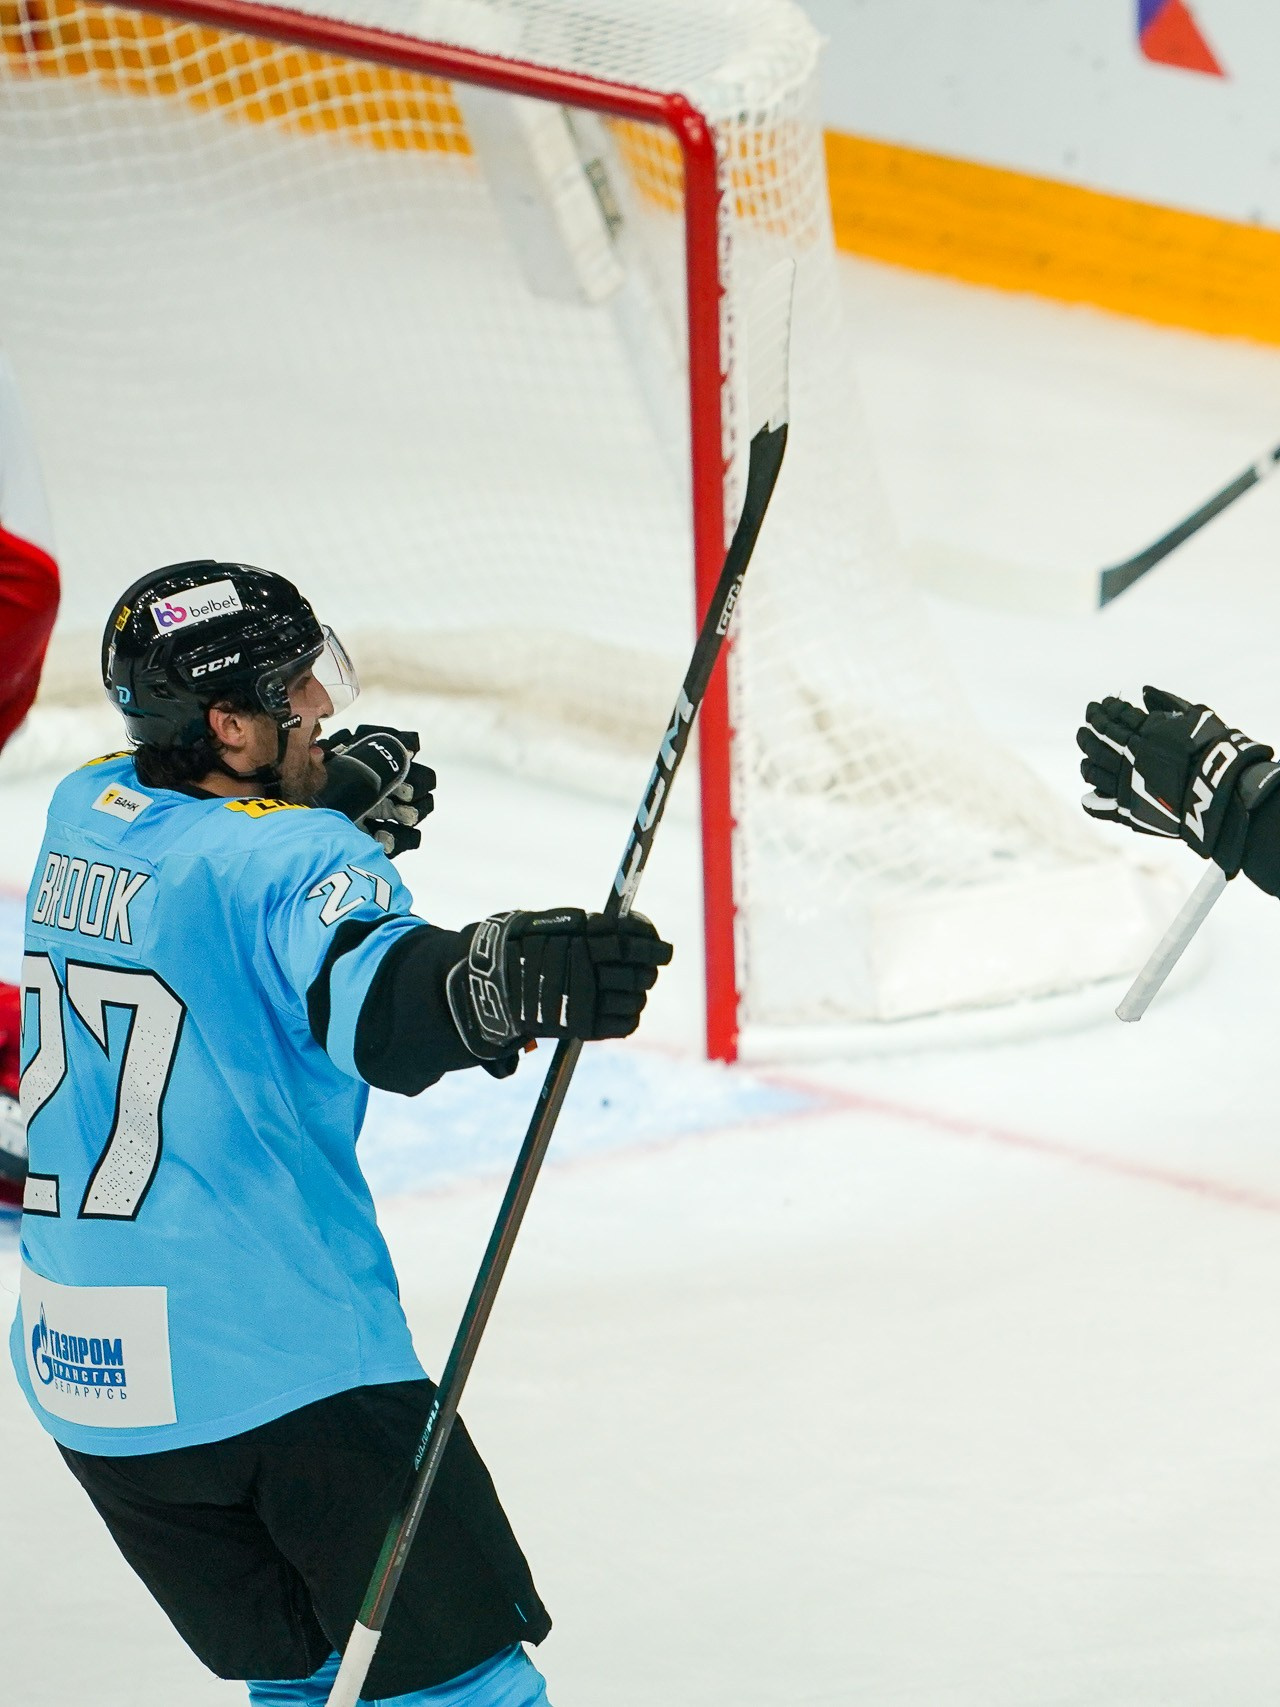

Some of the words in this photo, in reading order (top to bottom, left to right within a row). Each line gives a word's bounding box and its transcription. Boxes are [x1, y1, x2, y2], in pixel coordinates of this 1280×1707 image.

[189, 594, 239, 618] belbet
[718, 574, 746, 636] CCM
[191, 652, 241, 678] CCM
[281, 715, 301, 728] CCM
[367, 741, 399, 772] CCM
[114, 796, 140, 812] БАНК
[32, 850, 152, 945] BROOK
[306, 864, 393, 928] 27
[19, 951, 188, 1221] 27
[49, 1328, 124, 1367] ГАЗПРОМ
[54, 1363, 123, 1384] ТРАНСГАЗ
[54, 1379, 128, 1400] БЕЛАРУСЬ
